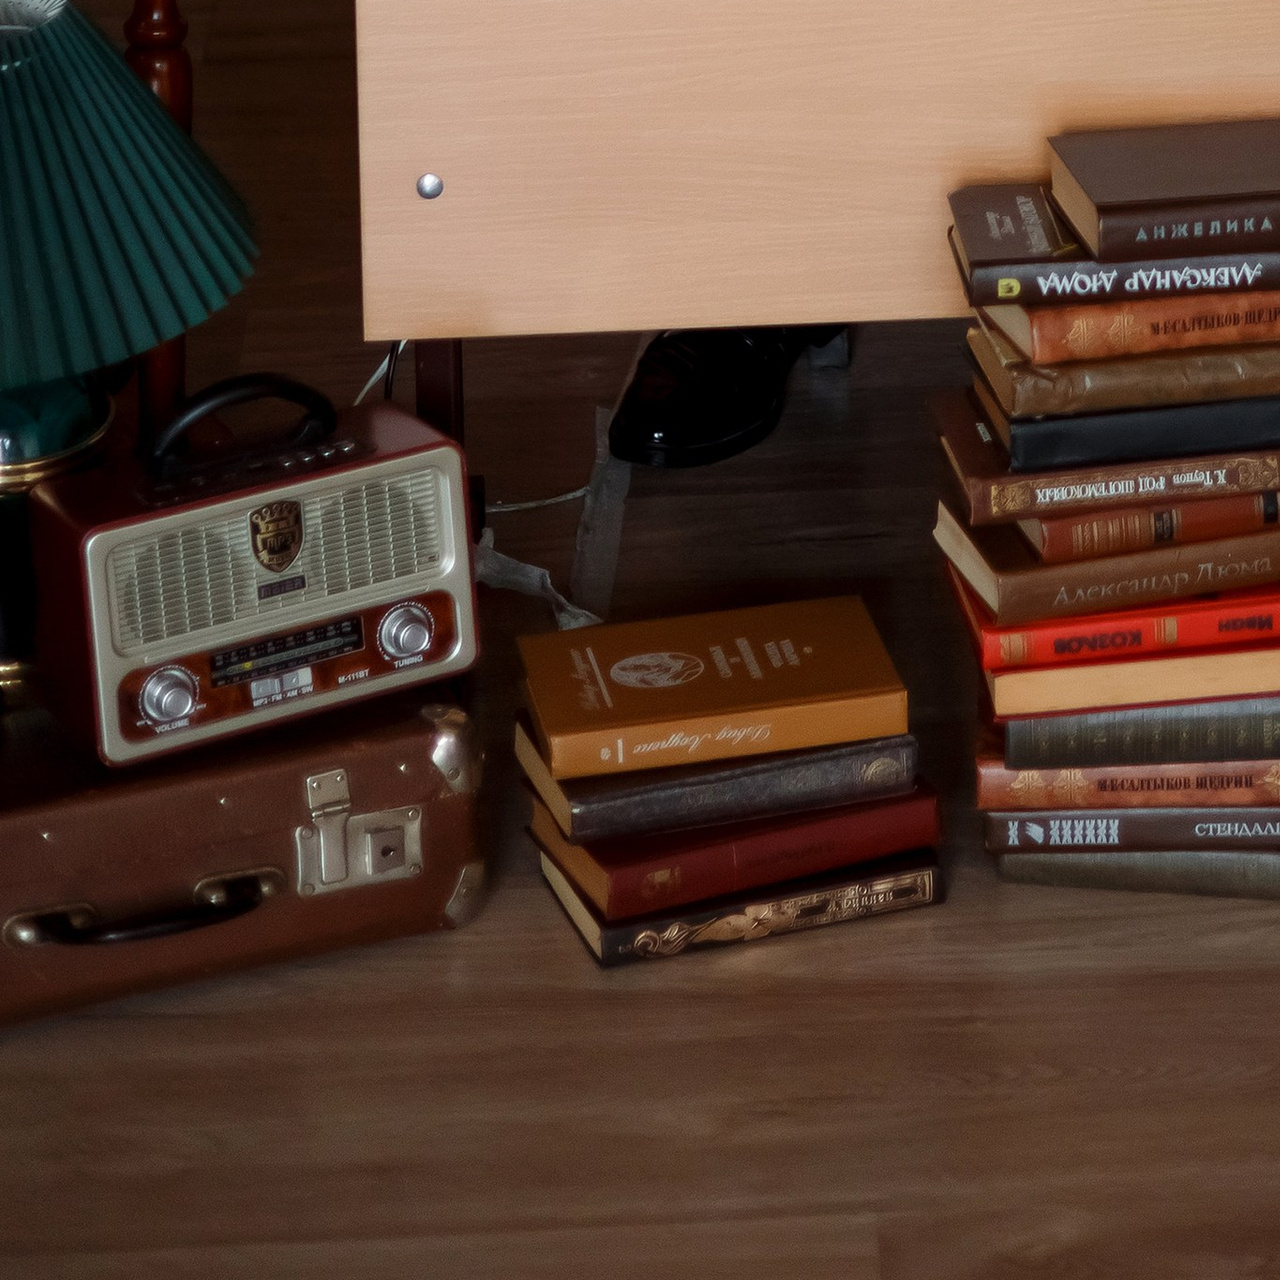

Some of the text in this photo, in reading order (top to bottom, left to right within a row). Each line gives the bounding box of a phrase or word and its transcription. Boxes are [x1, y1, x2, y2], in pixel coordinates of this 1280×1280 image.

[1135, 216, 1273, 242] АНЖЕЛИКА
[1037, 262, 1263, 297] АЛЕКСАНДР ДЮМА
[1138, 476, 1166, 493] РОД
[1053, 557, 1272, 606] Александр Дюма
[393, 654, 424, 669] TUNING
[154, 717, 190, 734] VOLUME
